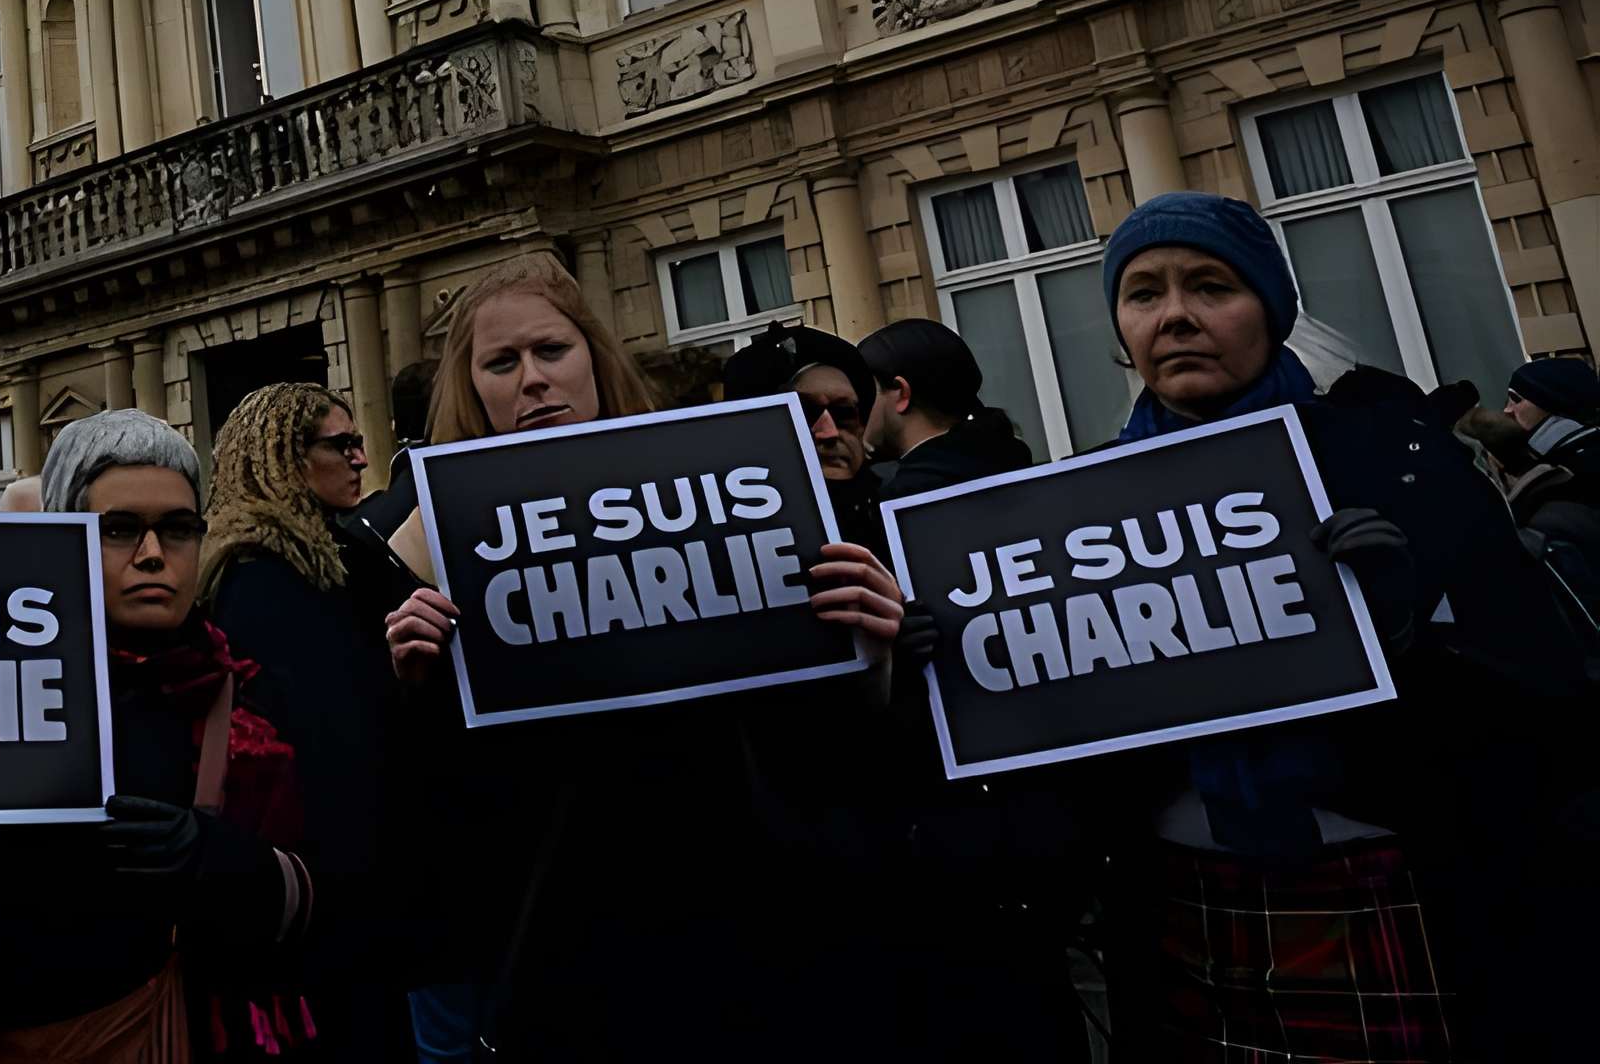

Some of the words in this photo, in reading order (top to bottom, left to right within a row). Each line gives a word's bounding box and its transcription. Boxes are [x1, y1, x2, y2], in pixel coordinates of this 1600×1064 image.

[473, 496, 577, 562] JE
[588, 466, 783, 542] SUIS
[947, 538, 1055, 608] JE
[1064, 491, 1281, 581] SUIS
[484, 527, 810, 645] CHARLIE
[961, 553, 1317, 692] CHARLIE
